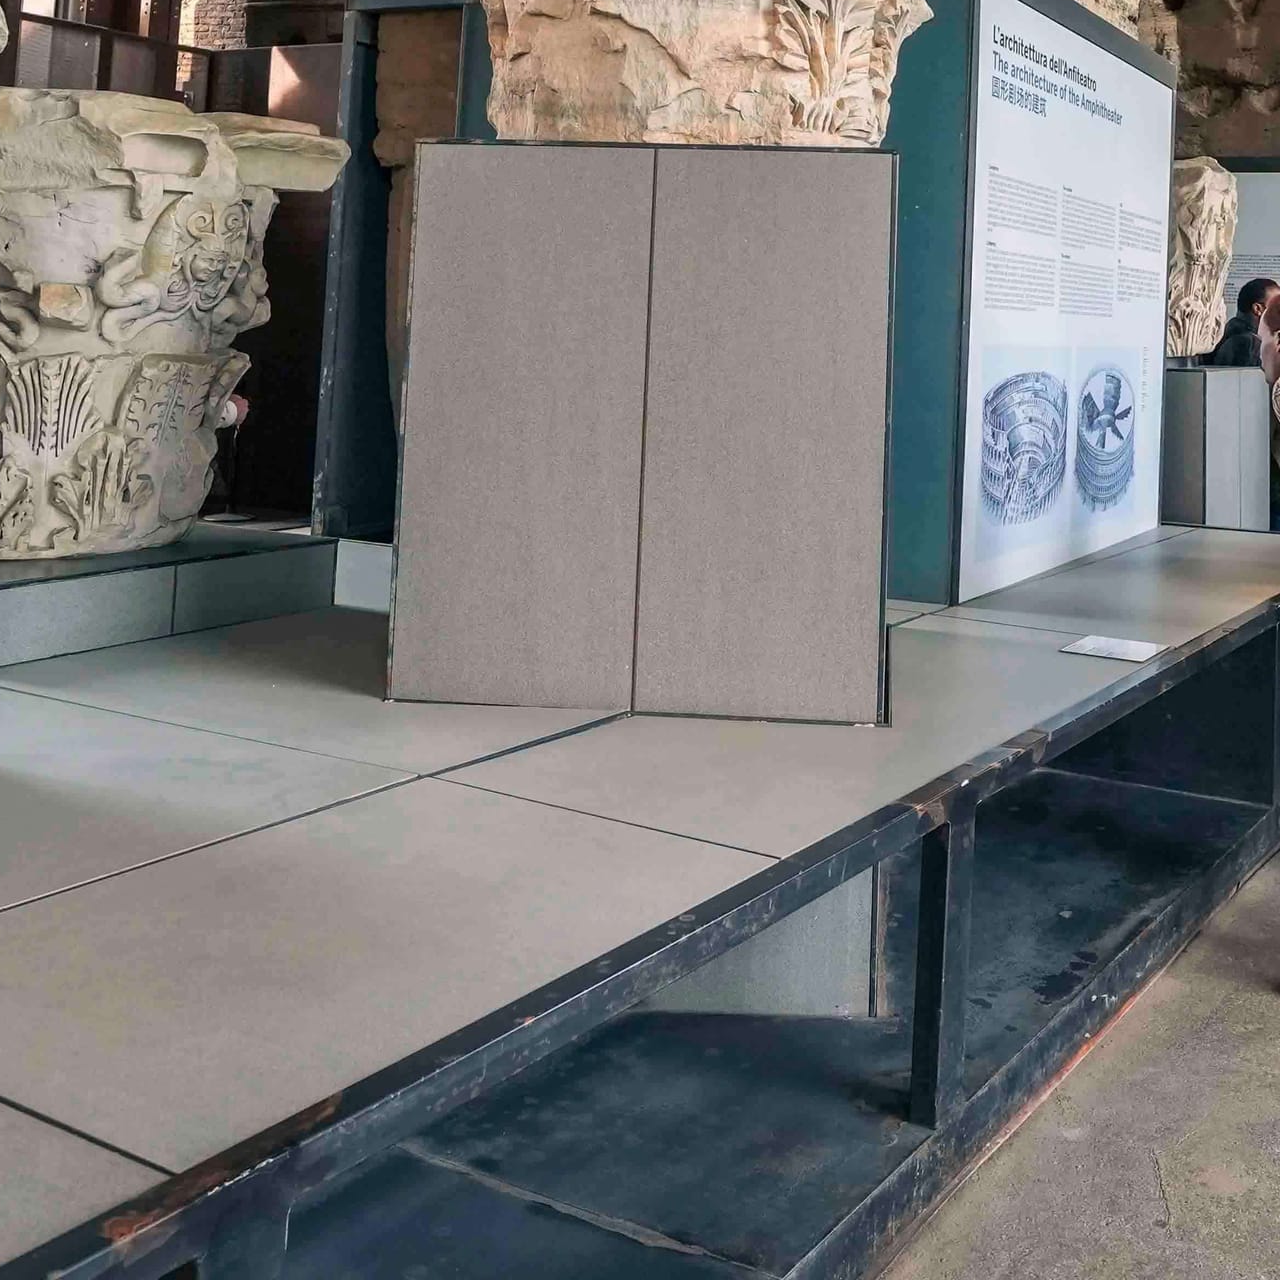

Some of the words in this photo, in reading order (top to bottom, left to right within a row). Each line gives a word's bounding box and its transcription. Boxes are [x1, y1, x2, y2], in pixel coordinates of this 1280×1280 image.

[993, 24, 1048, 68] L'architettura
[1049, 54, 1097, 92] dell'Anfiteatro
[993, 50, 1009, 74] The
[1011, 64, 1058, 97] architecture
[1060, 84, 1067, 100] of
[1069, 86, 1080, 106] the
[1081, 93, 1122, 126] Amphitheater
